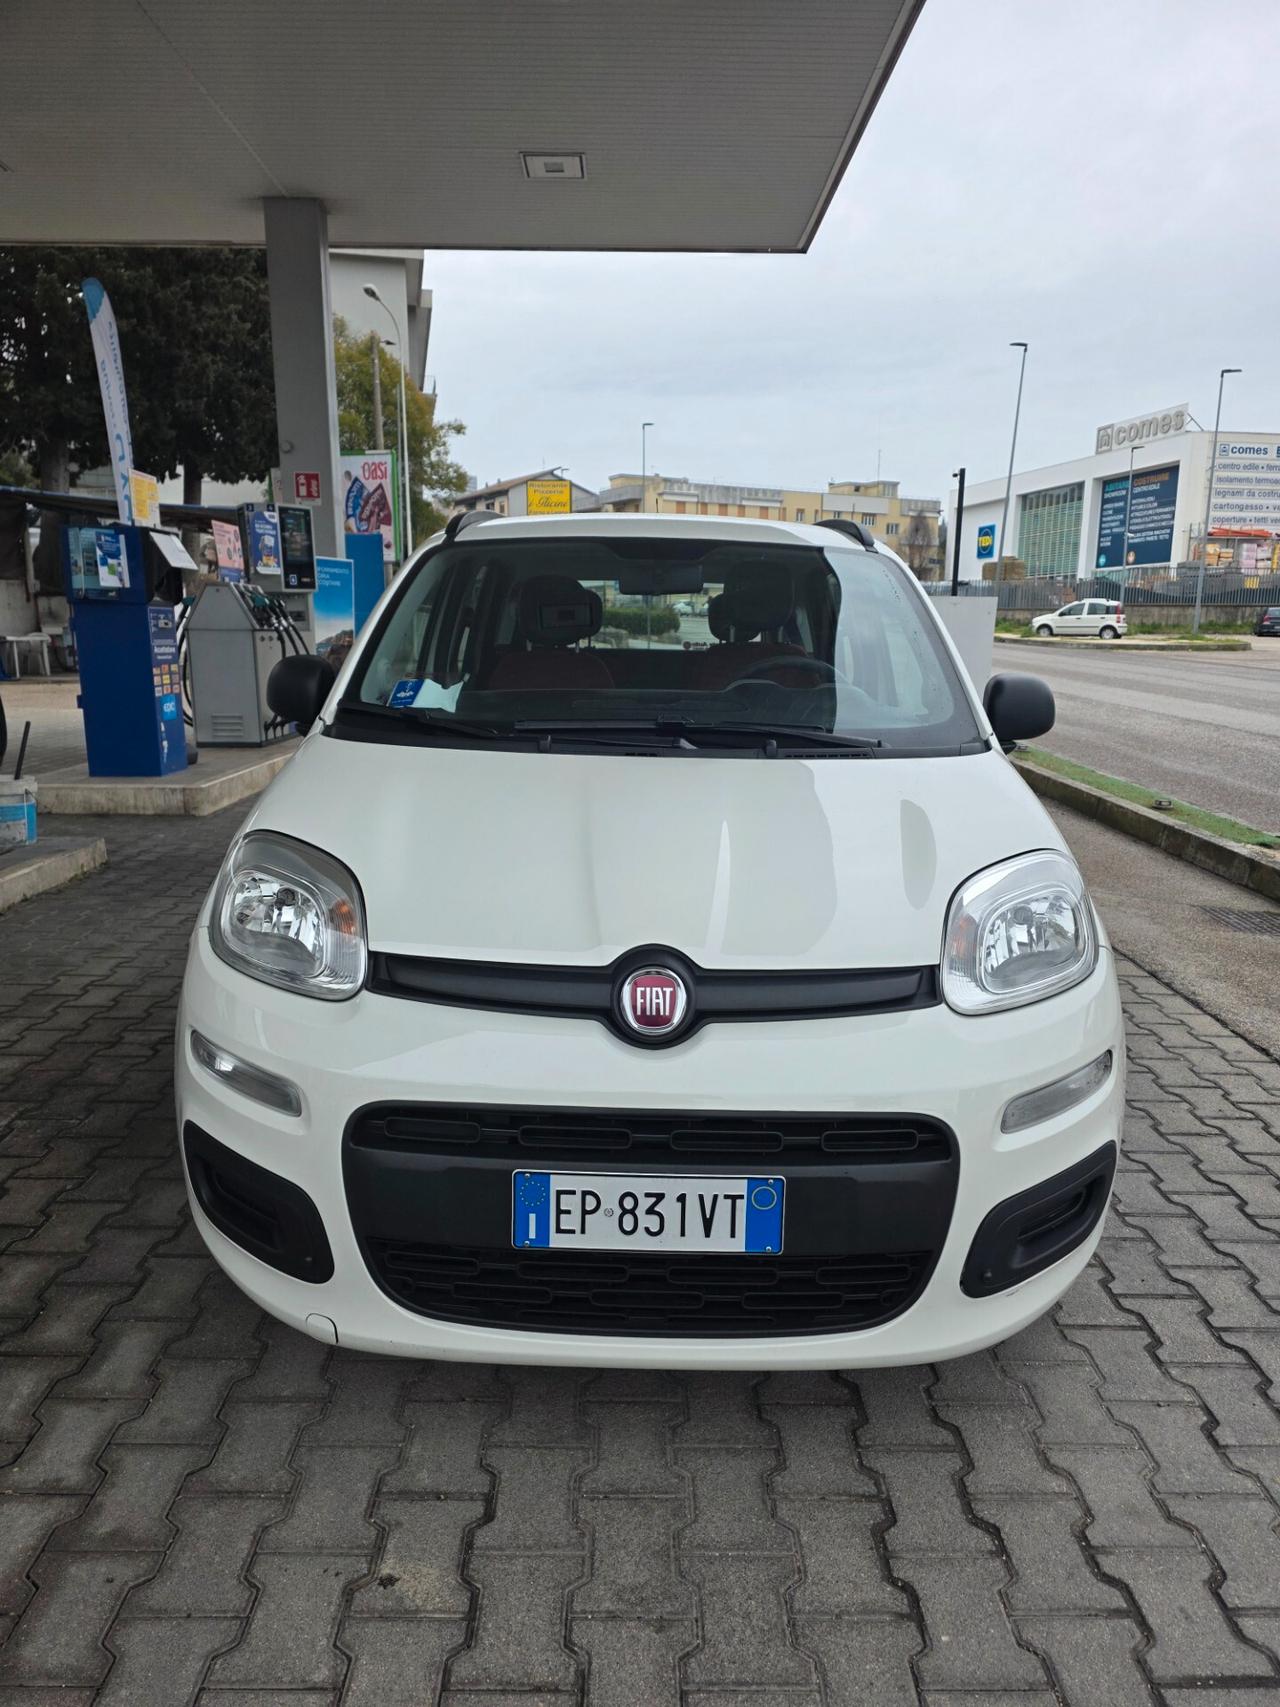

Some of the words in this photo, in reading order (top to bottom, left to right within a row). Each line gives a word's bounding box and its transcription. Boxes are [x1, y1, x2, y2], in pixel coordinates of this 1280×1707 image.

[1114, 410, 1185, 445] comes
[1231, 446, 1268, 455] comes
[1215, 490, 1244, 498] legnami
[1213, 503, 1263, 511] cartongesso
[1212, 516, 1247, 524] coperture
[636, 987, 673, 1016] FIAT
